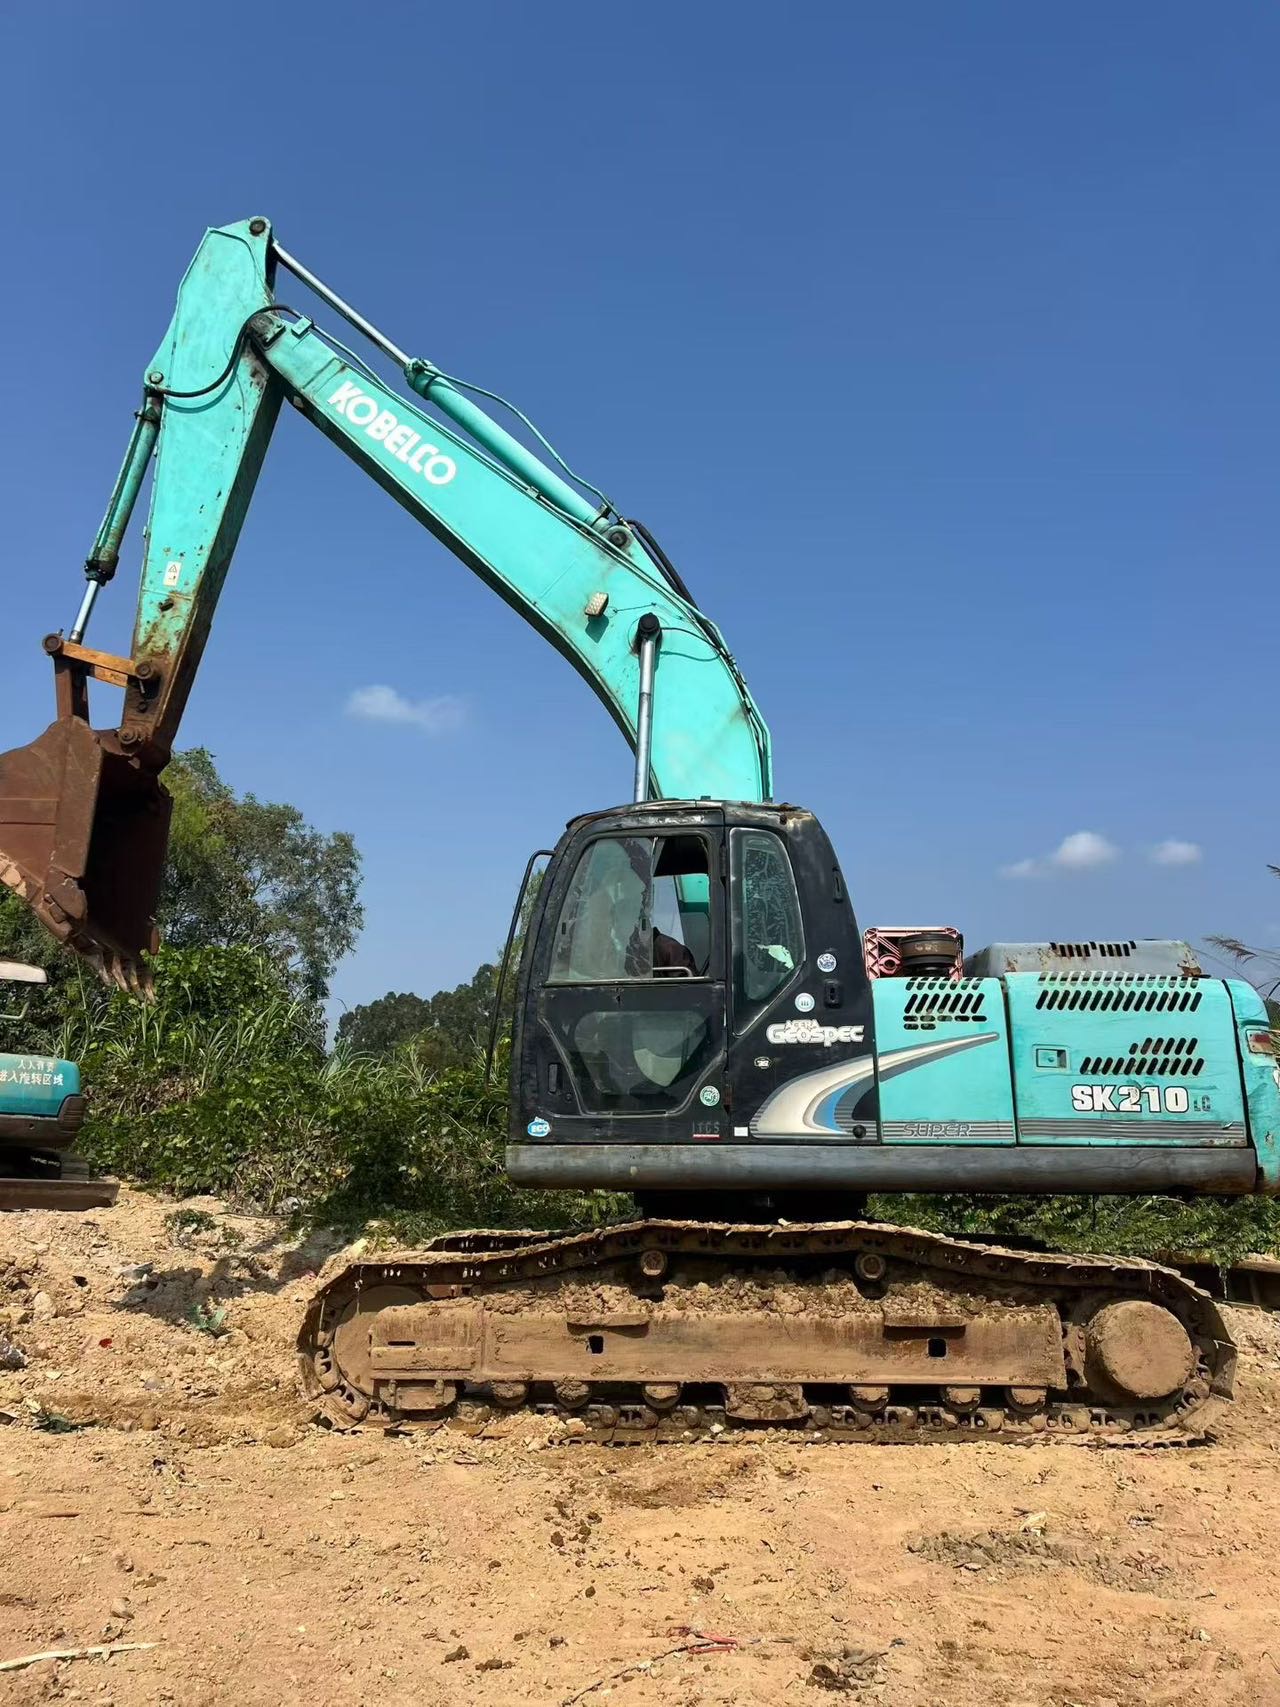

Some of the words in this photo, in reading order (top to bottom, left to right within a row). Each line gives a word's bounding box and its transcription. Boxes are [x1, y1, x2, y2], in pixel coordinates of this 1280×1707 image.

[327, 380, 457, 485] KOBELCO
[1071, 1083, 1189, 1113] SK210
[903, 1122, 970, 1137] SUPER
